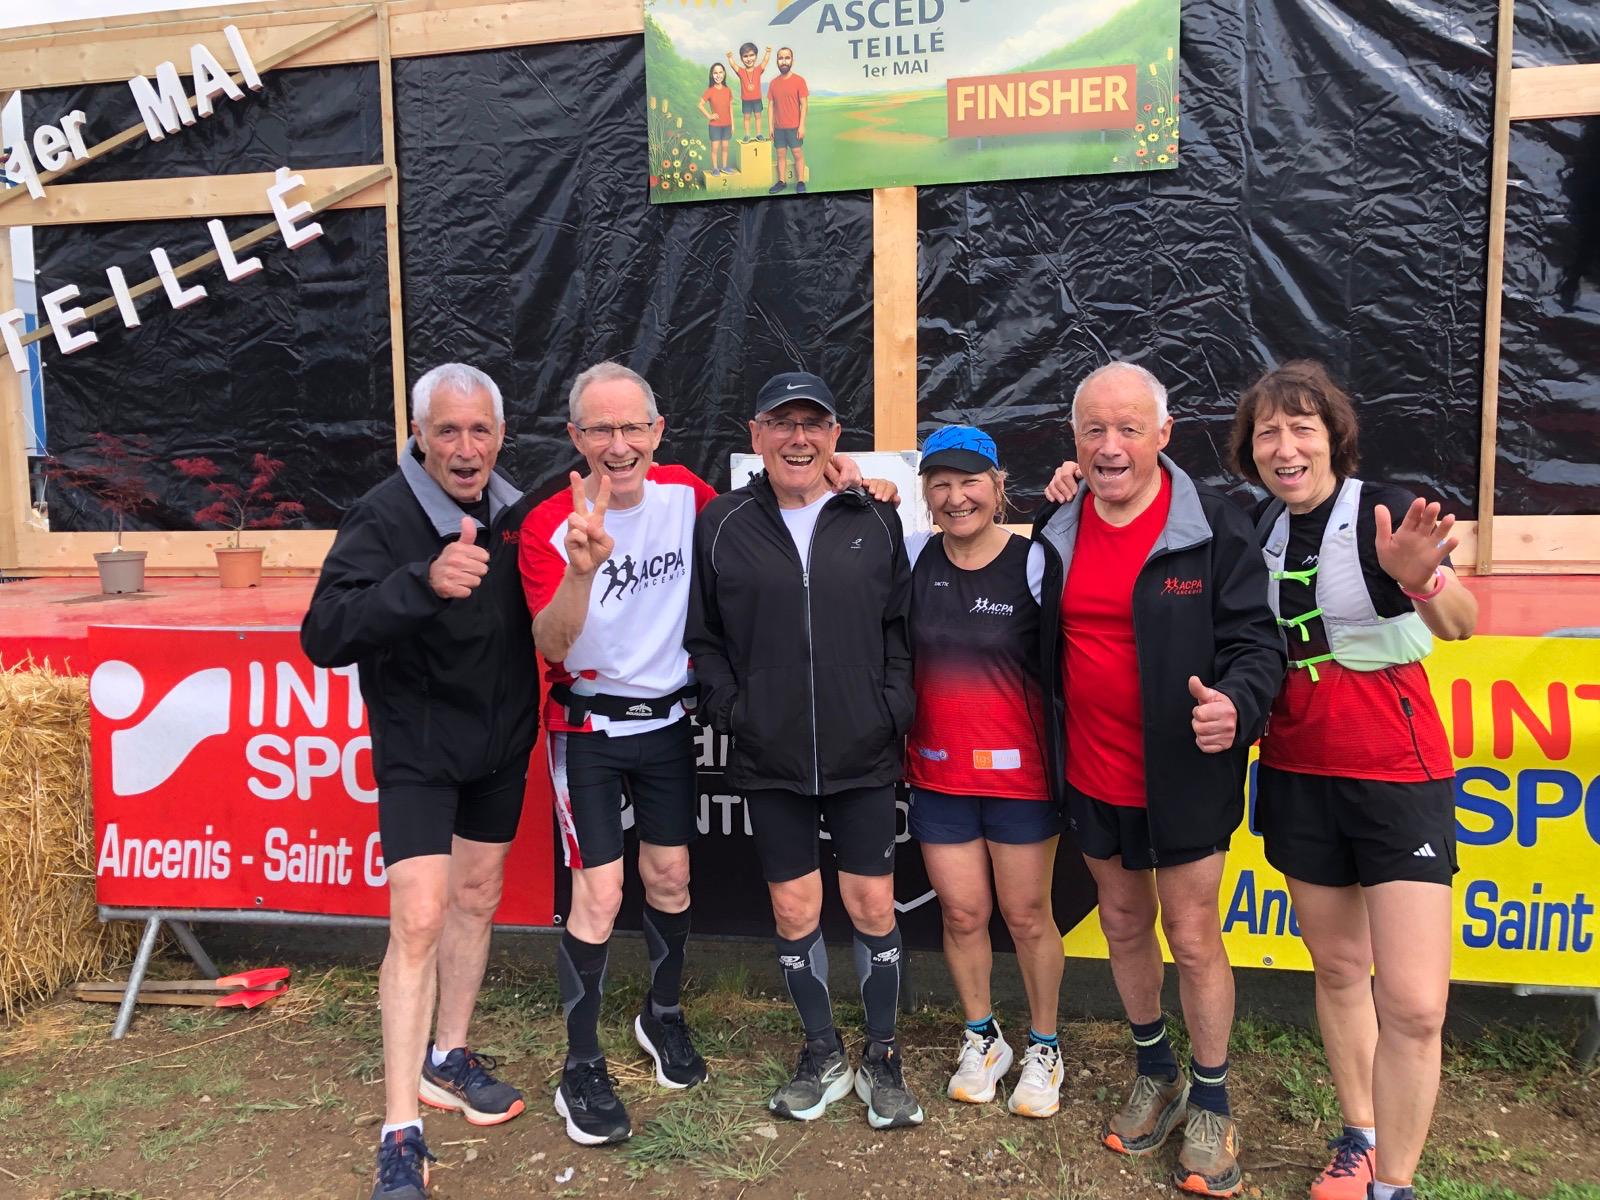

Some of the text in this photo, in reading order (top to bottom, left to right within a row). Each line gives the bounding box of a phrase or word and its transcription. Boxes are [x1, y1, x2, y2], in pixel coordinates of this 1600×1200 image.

[817, 0, 945, 33] ASCED
[848, 27, 945, 60] TEILLÉ
[128, 24, 264, 142] MAI
[862, 59, 928, 78] 1er MAI
[956, 75, 1130, 121] FINISHER
[0, 166, 323, 374] TEILLÉ
[639, 547, 684, 582] ACPA
[1179, 579, 1203, 590] ACPA
[988, 602, 1014, 614] ACPA
[1454, 766, 1600, 848] SP
[97, 823, 231, 880] Ancenis
[263, 827, 352, 886] Saint
[1462, 880, 1595, 953] Saint
